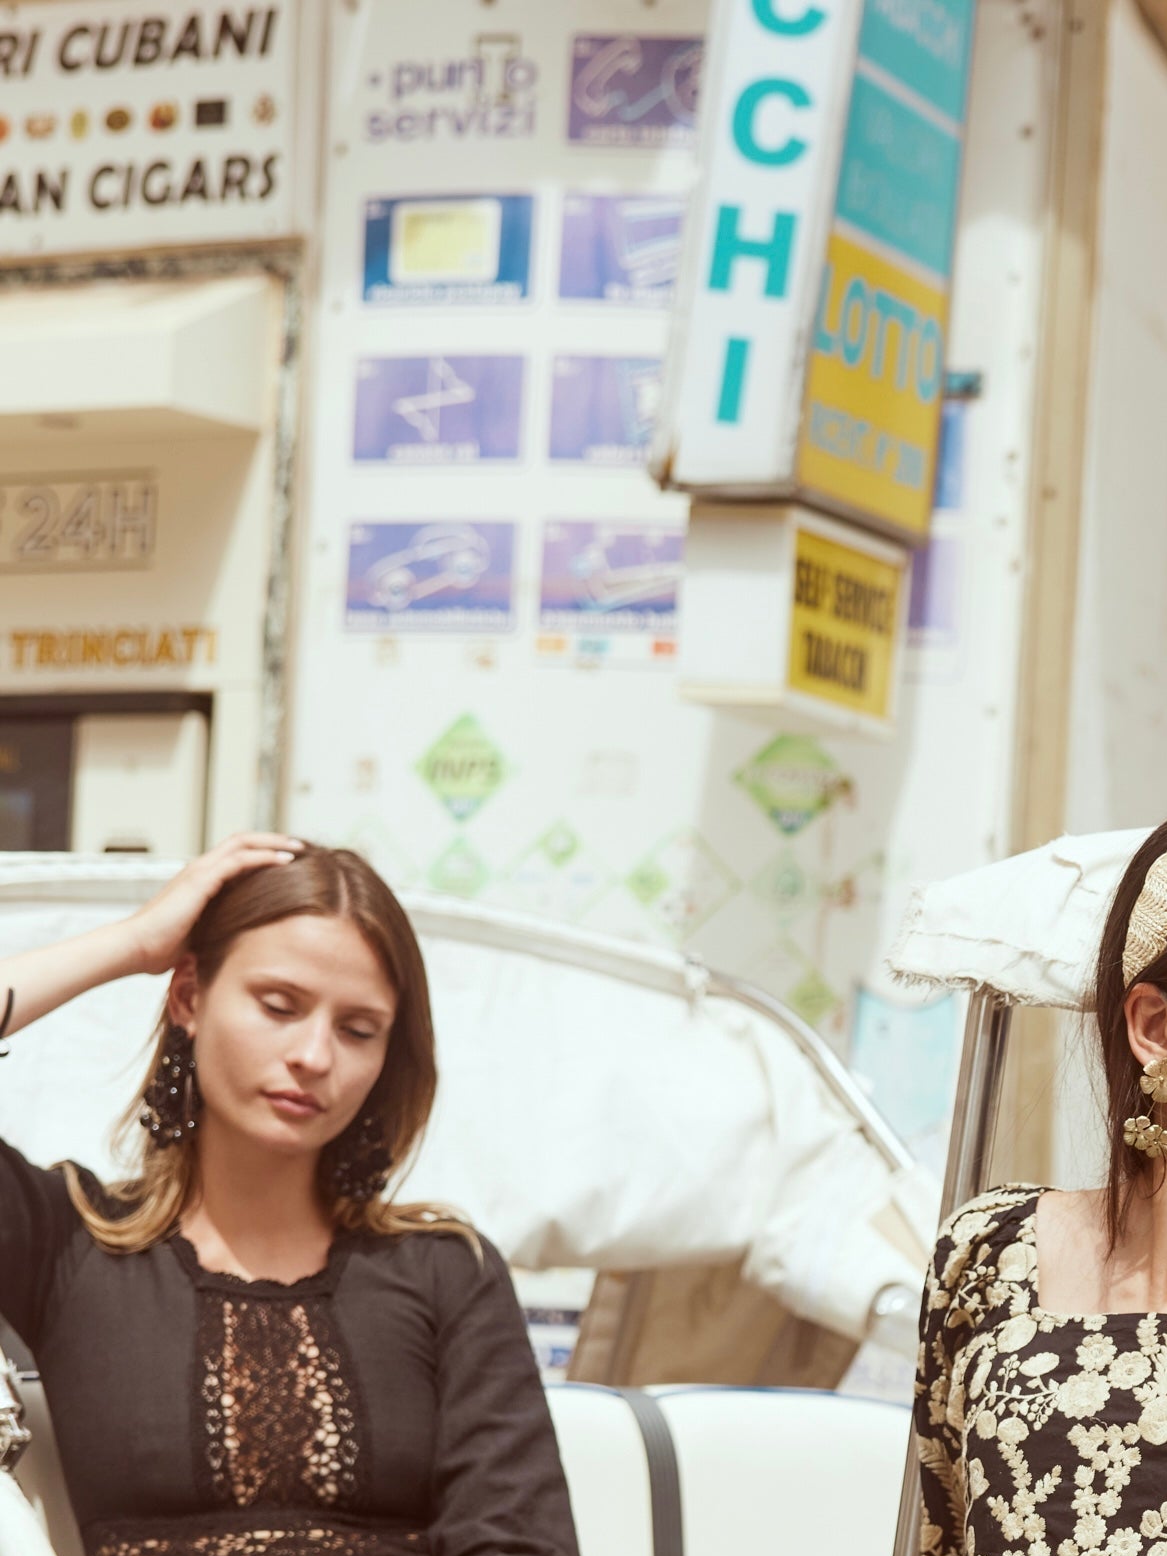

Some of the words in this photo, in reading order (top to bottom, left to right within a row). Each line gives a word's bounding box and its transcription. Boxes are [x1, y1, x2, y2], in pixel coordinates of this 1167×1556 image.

[57, 8, 277, 72] CUBANI
[0, 169, 67, 215] AN
[88, 152, 279, 210] CIGARS
[812, 262, 946, 405] LOTTO
[11, 487, 158, 562] 24H
